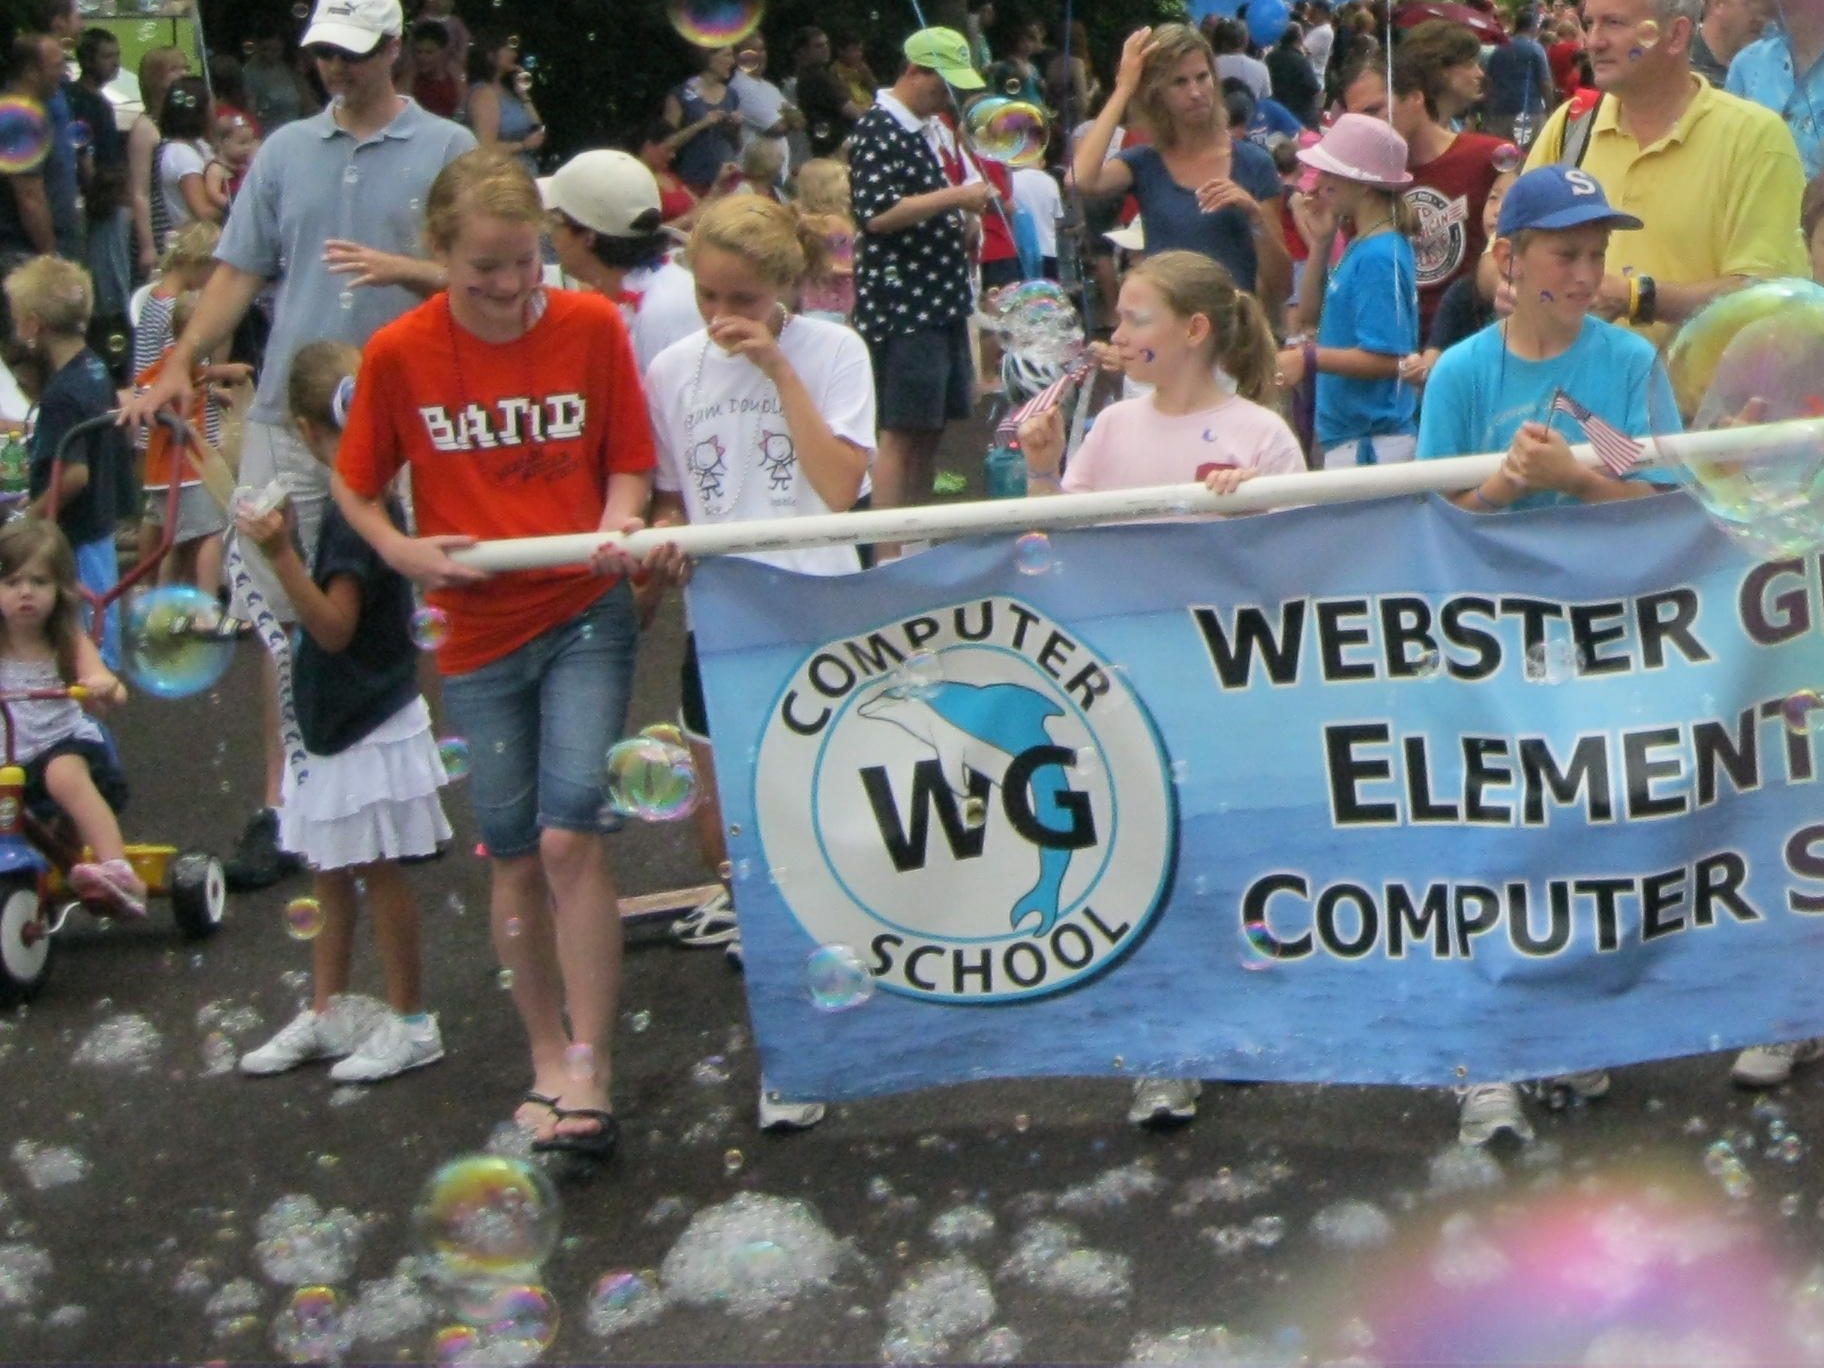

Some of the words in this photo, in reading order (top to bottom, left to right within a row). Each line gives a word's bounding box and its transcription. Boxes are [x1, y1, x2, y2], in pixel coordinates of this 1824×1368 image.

[1565, 170, 1596, 196] S
[418, 392, 587, 452] BAND
[781, 600, 1111, 736] COMPUTER
[1192, 587, 1713, 691] WEBSTER
[858, 743, 1098, 874] WG
[869, 905, 1131, 994] SCHOOL
[1241, 850, 1760, 959] COMPUTER
